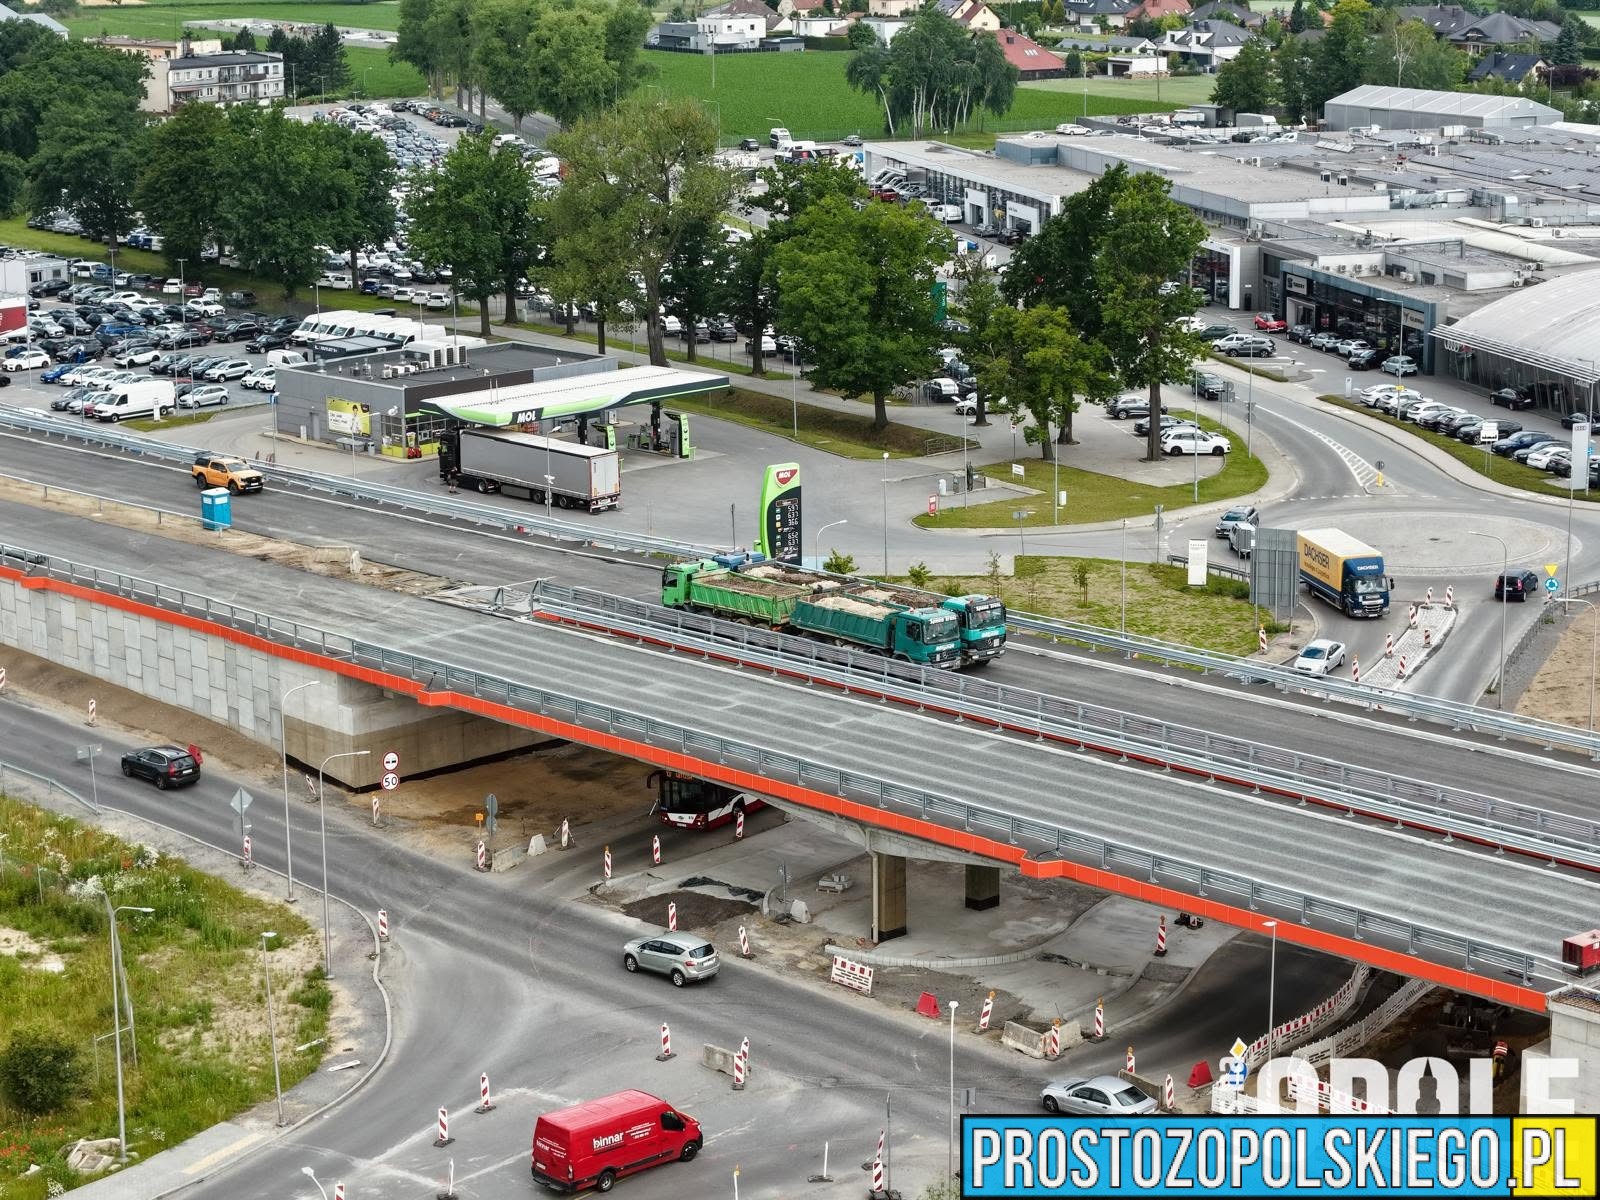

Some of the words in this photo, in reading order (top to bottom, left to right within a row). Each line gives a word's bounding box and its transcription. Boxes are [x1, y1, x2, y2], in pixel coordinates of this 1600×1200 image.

[517, 410, 536, 423] MOL
[778, 471, 791, 479] MOL
[1304, 543, 1329, 570] DACHSER
[385, 777, 397, 787] 50
[593, 1132, 624, 1149] binnar
